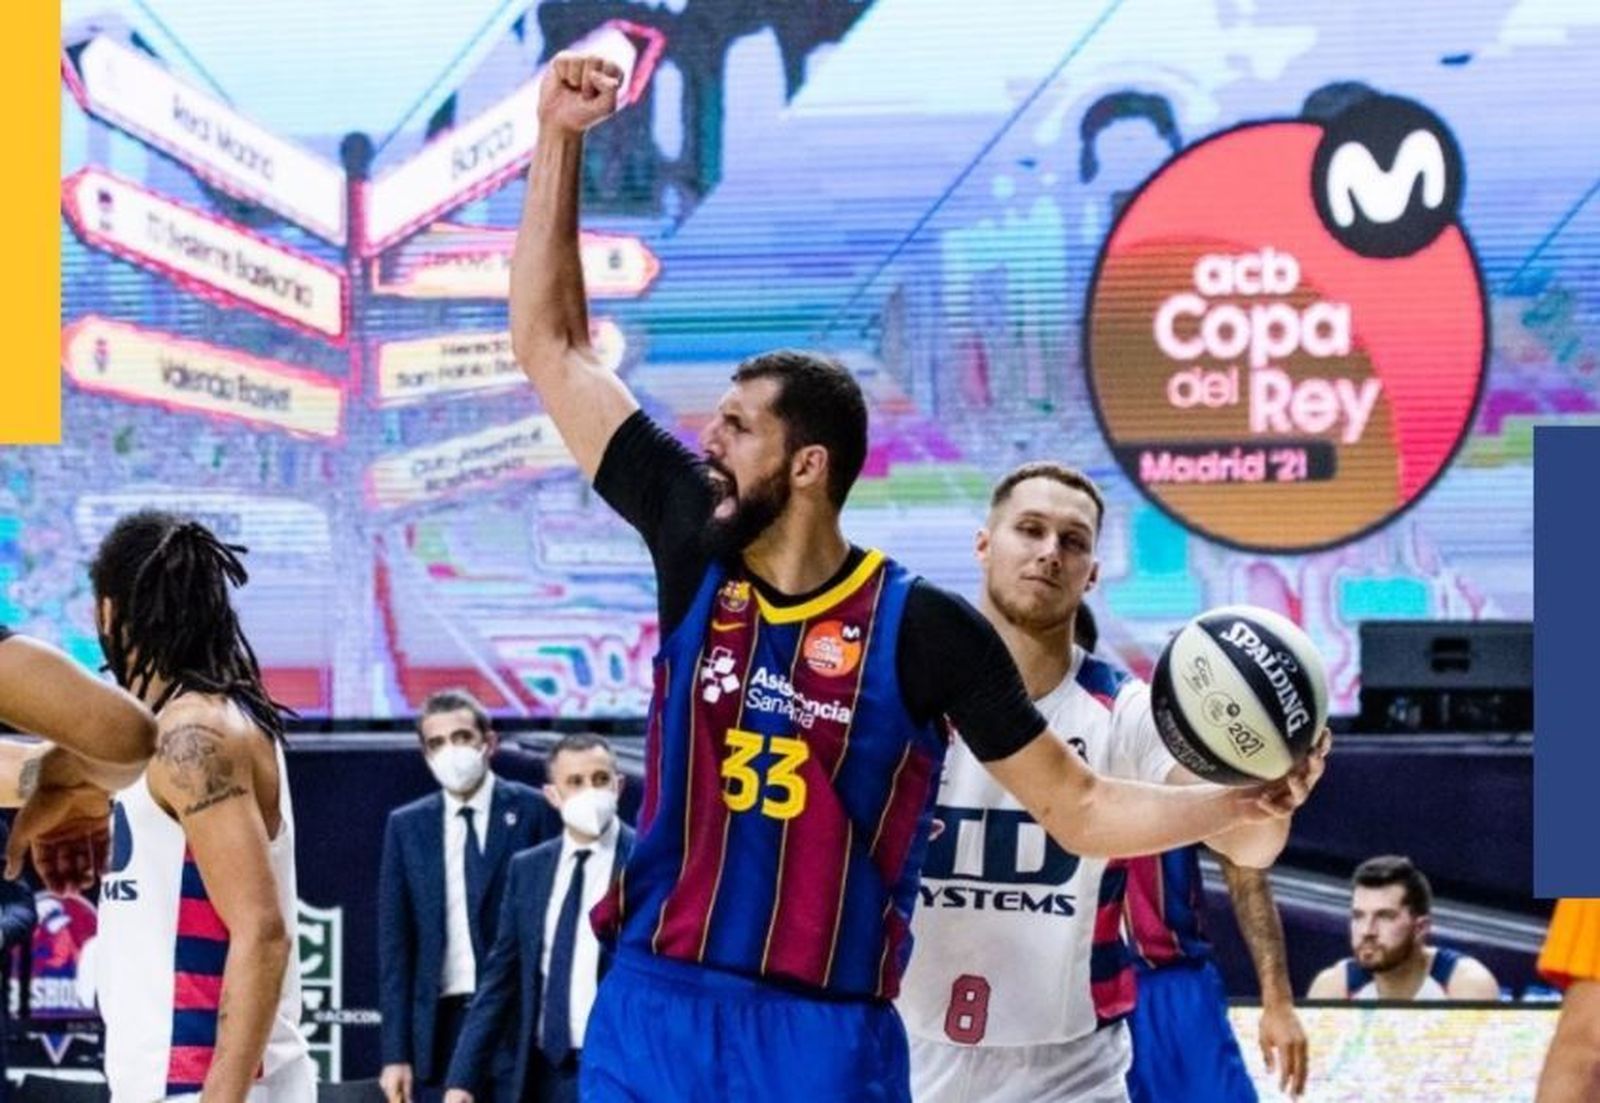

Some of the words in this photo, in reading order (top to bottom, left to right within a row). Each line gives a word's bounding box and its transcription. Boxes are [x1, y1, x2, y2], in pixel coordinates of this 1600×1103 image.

[1193, 247, 1301, 297] acb
[1154, 293, 1352, 370] Copa
[1167, 366, 1240, 408] del
[1249, 369, 1383, 444] Rey
[1138, 447, 1267, 482] Madrid
[1219, 621, 1310, 739] SPALDING
[721, 728, 810, 820] 33
[1228, 721, 1266, 758] 2021
[920, 884, 1077, 917] YSTEMS
[944, 973, 992, 1045] 8
